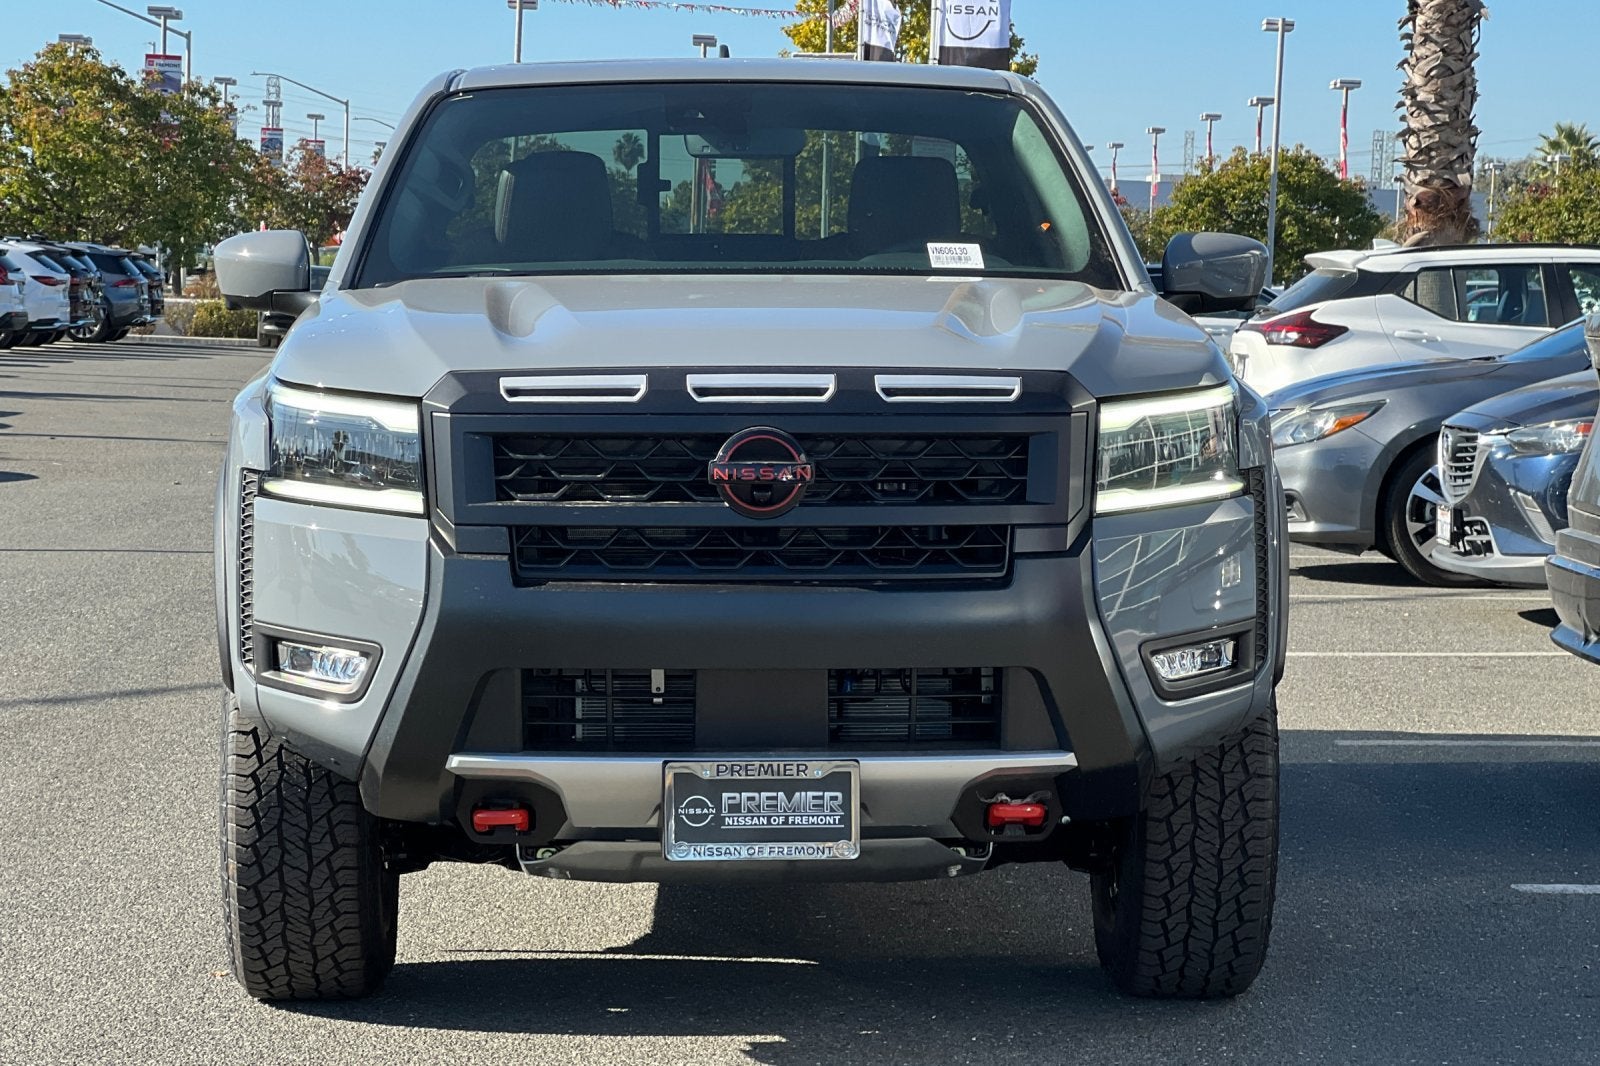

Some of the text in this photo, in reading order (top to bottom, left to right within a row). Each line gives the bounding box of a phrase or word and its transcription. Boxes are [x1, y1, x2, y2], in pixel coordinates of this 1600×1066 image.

[713, 466, 811, 480] NISSAN
[716, 763, 809, 777] PREMIER
[722, 791, 843, 813] PREMIER
[678, 807, 716, 815] NISSAN
[725, 815, 841, 826] NISSAN OF FREMONT
[692, 845, 834, 857] NISSAN OF FREMONT
